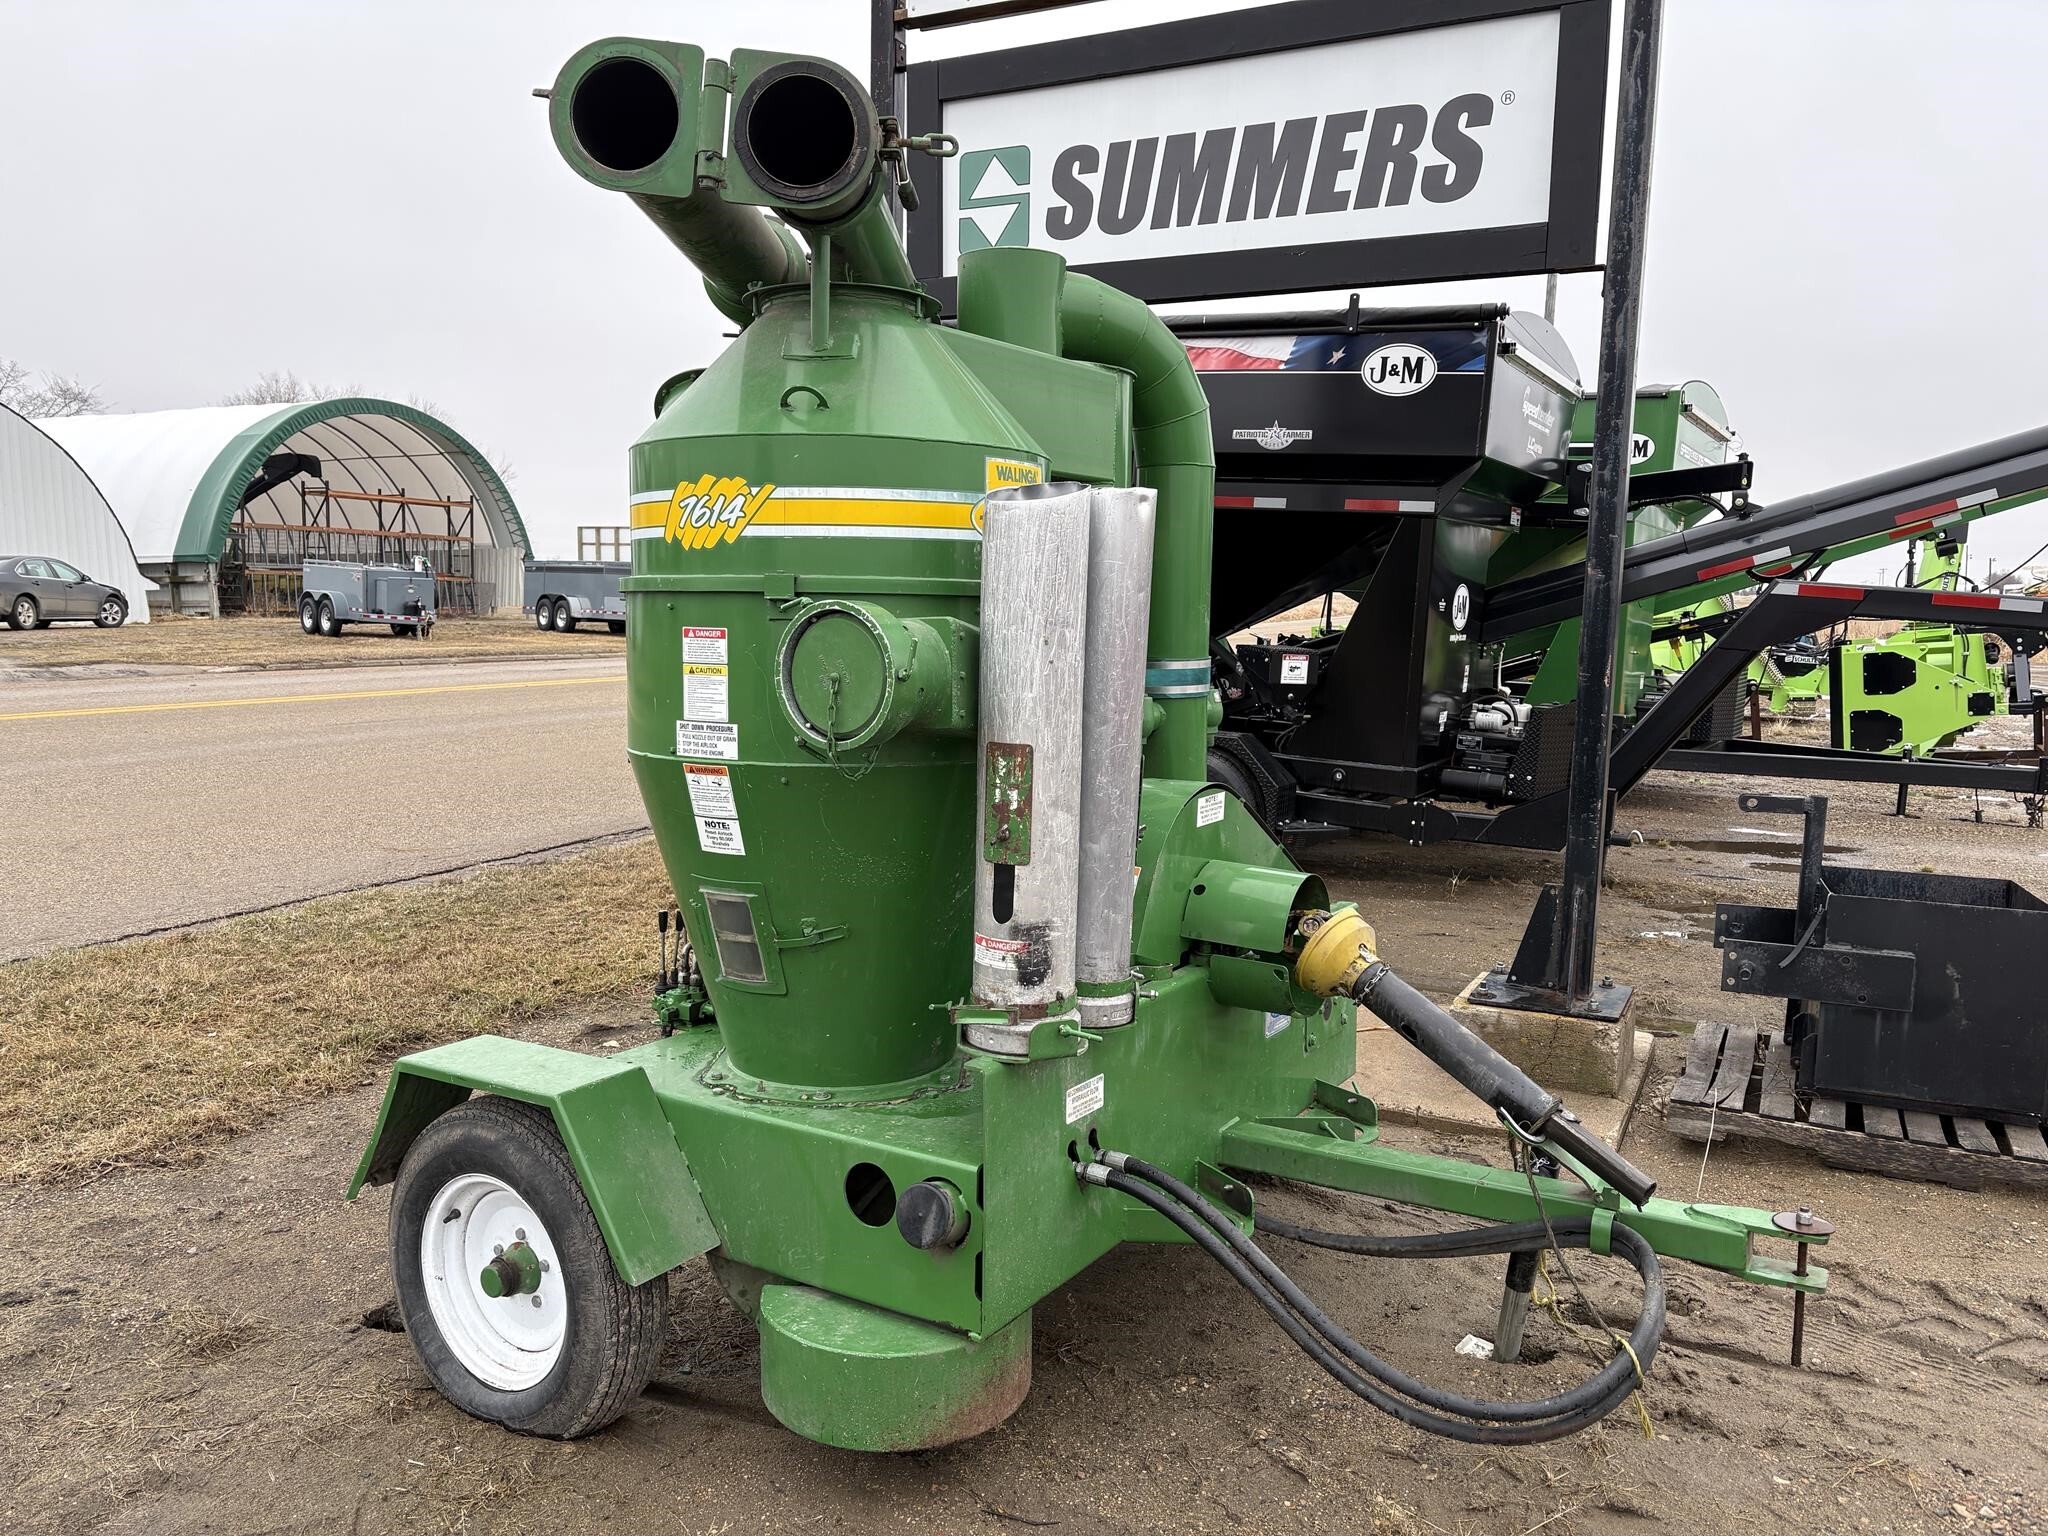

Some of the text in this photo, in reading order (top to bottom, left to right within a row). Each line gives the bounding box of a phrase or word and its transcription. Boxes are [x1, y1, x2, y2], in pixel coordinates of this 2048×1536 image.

[1369, 356, 1425, 384] J&M
[1235, 431, 1310, 439] PATRIOTIC FARMER
[996, 465, 1037, 484] WALINGA
[679, 494, 746, 529] 7614
[695, 630, 722, 638] DANGER
[695, 667, 722, 675] CAUTION
[706, 724, 734, 733] PROCEDURE
[695, 767, 723, 775] WARNING
[704, 820, 730, 830] NOTE:
[987, 940, 1017, 951] DANGER
